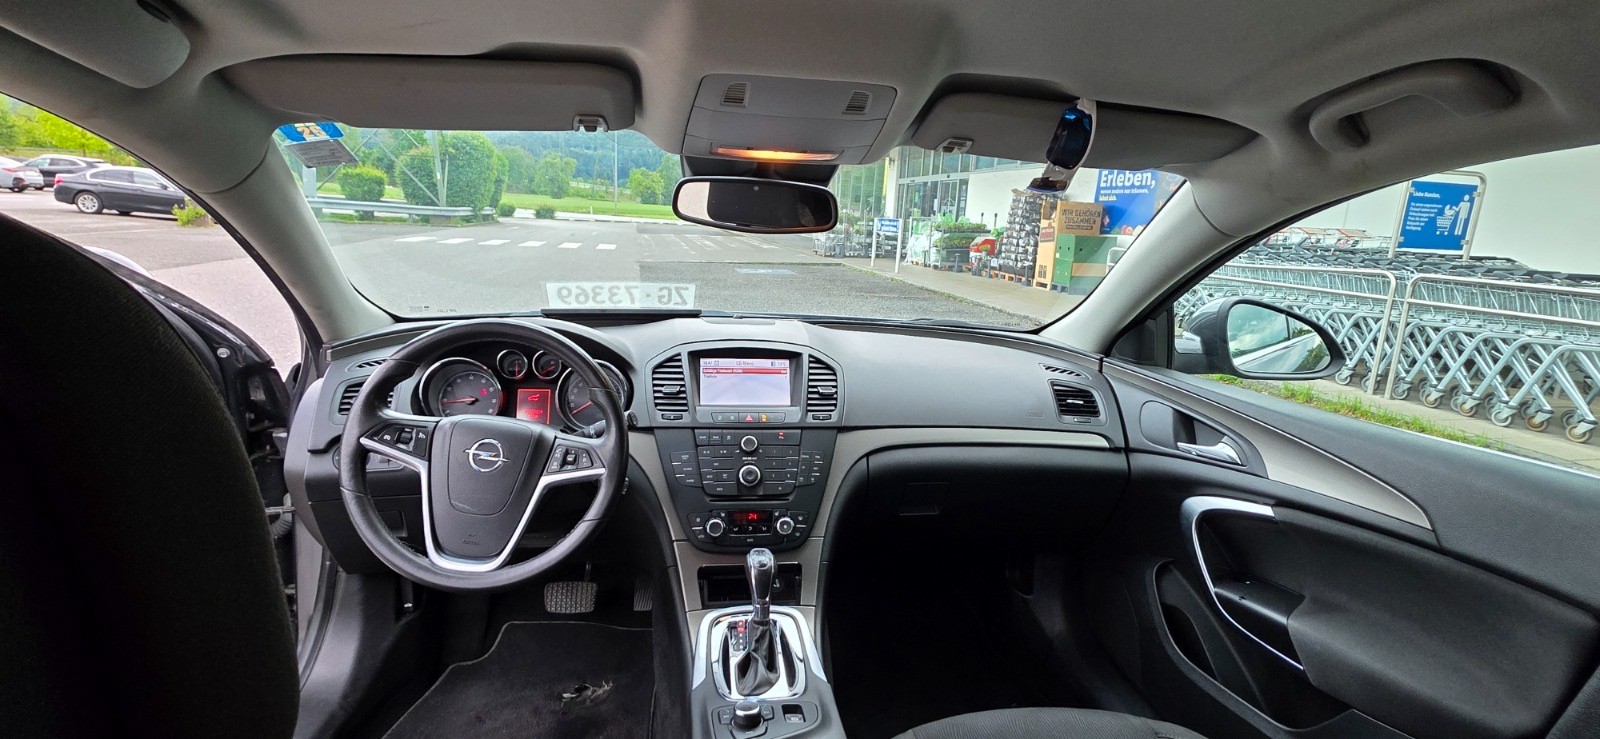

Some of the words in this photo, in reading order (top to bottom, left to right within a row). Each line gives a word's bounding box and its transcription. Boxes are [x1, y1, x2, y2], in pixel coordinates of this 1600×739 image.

[1100, 170, 1156, 189] Erleben,
[1062, 208, 1073, 217] WIR
[1064, 217, 1096, 225] ZUSAMMEN
